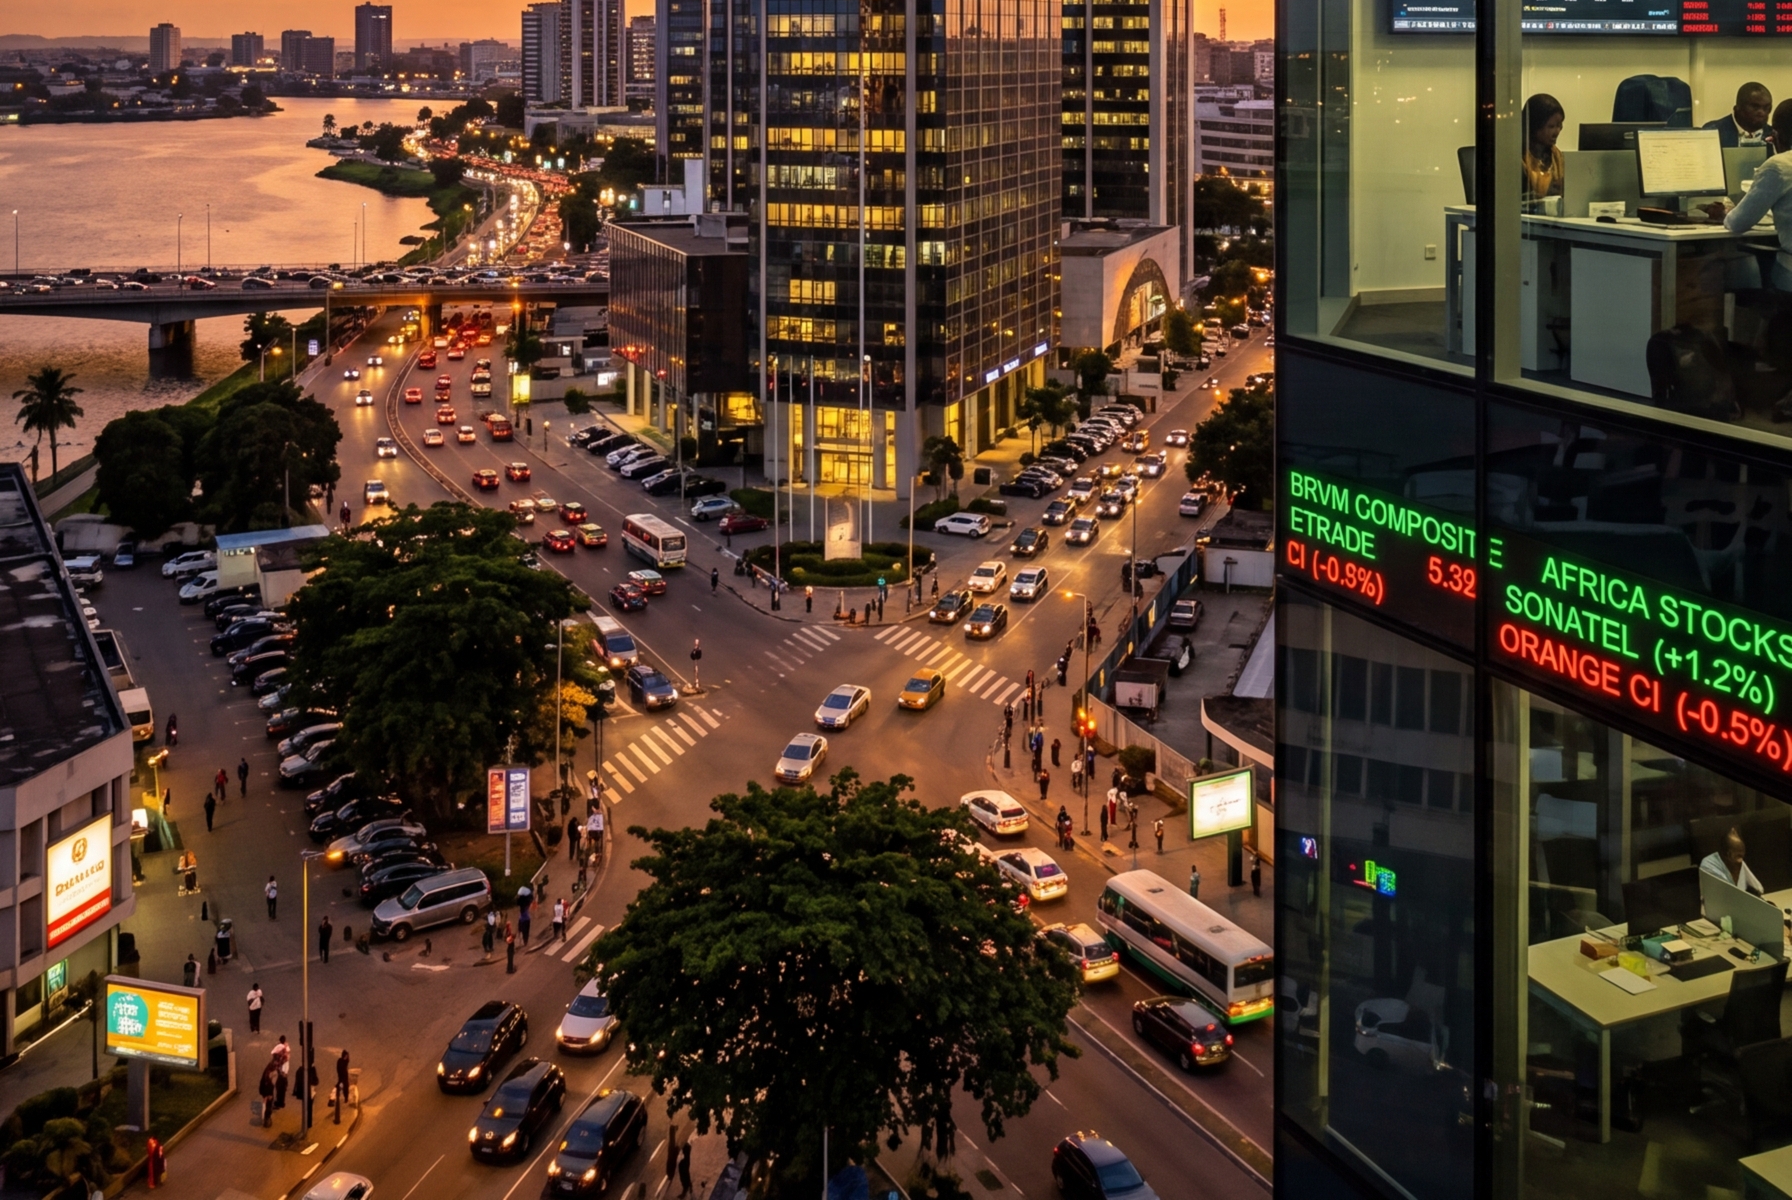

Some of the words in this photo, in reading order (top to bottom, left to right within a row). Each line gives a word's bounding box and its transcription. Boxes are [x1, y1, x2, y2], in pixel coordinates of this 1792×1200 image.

[1287, 539, 1306, 570] CI
[1290, 471, 1350, 515] BRVM
[1354, 493, 1503, 569] COMPOSITE
[1290, 505, 1376, 560] ETRADE
[1505, 584, 1640, 660] SONATEL
[1654, 638, 1775, 715] (+1.2%)
[1540, 556, 1651, 620] AFRICA
[1658, 594, 1792, 670] STOCKS
[1499, 623, 1621, 697] ORANGE
[1628, 673, 1661, 713] CI
[1676, 691, 1792, 772] (-0.5%)
